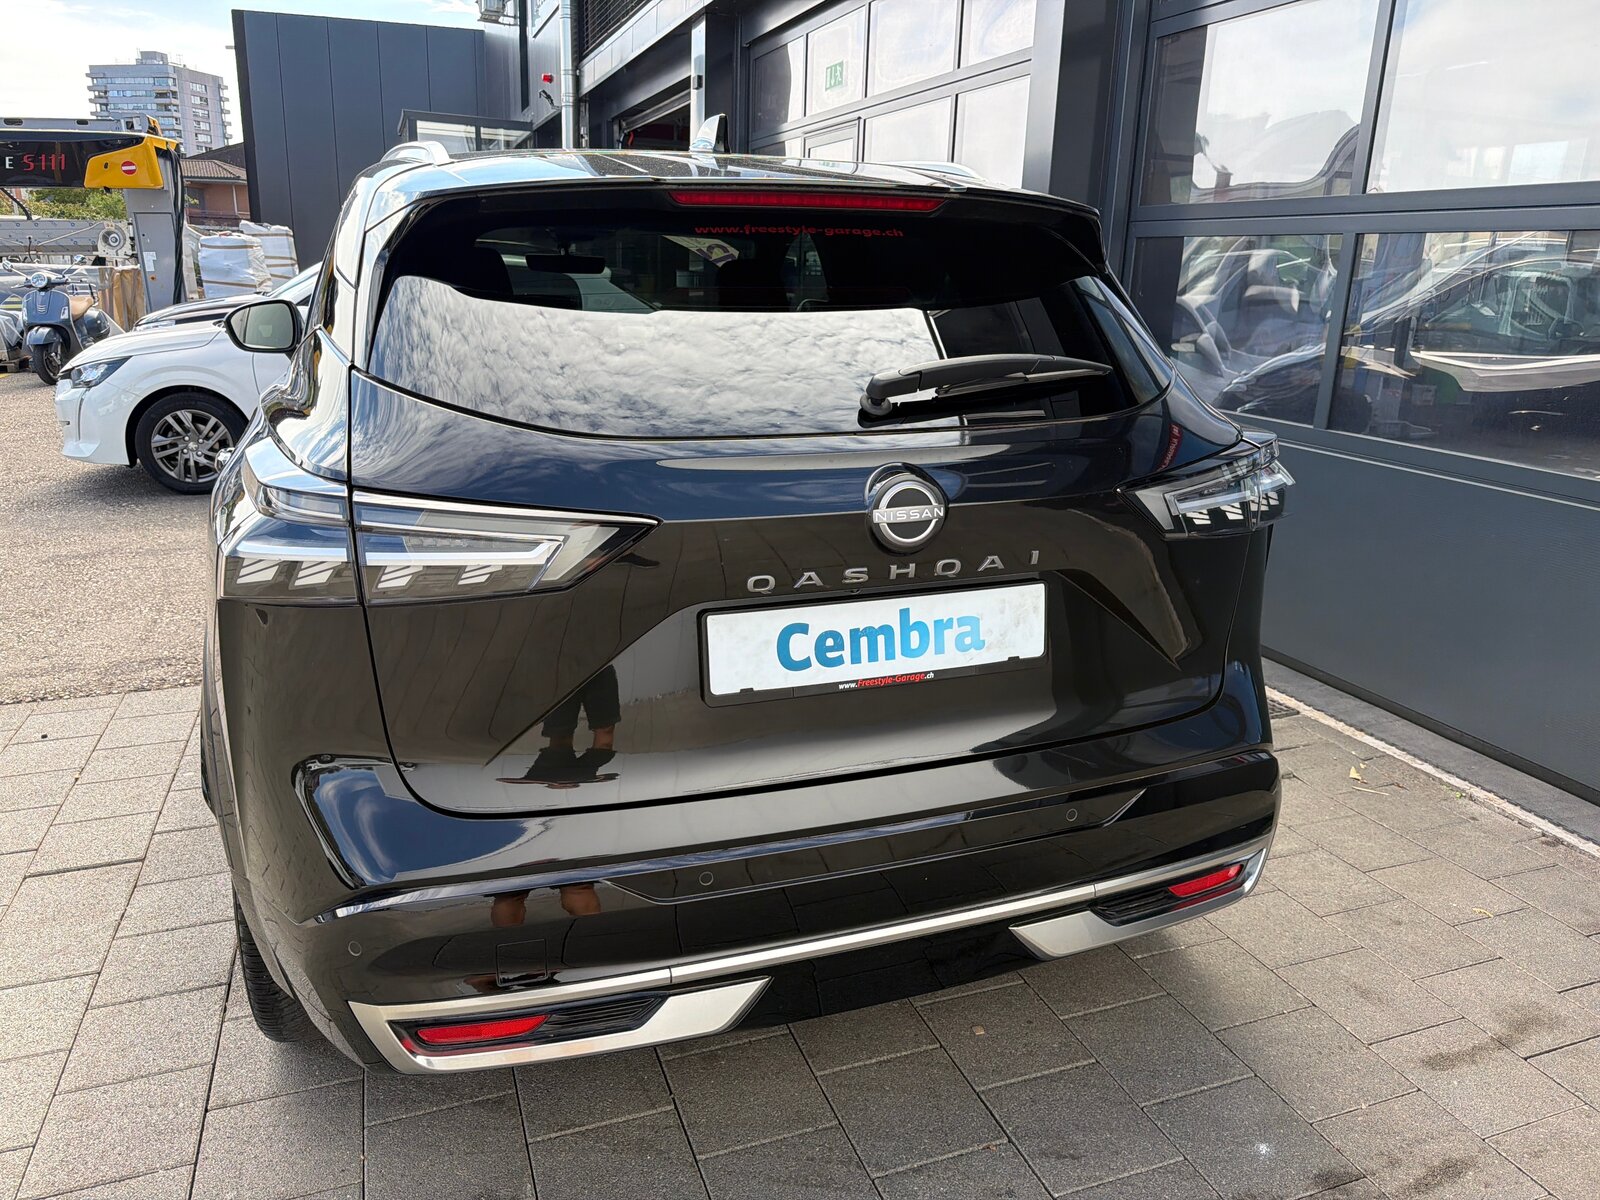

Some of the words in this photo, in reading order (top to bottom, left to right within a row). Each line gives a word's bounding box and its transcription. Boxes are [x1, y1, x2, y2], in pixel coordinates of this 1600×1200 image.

[694, 224, 904, 238] www.freestyle-garage.ch
[874, 506, 945, 522] NISSAN
[746, 550, 1040, 595] QASHQAI
[776, 608, 986, 672] Cembra
[838, 672, 935, 690] www.Freestyle-Garage.ch
